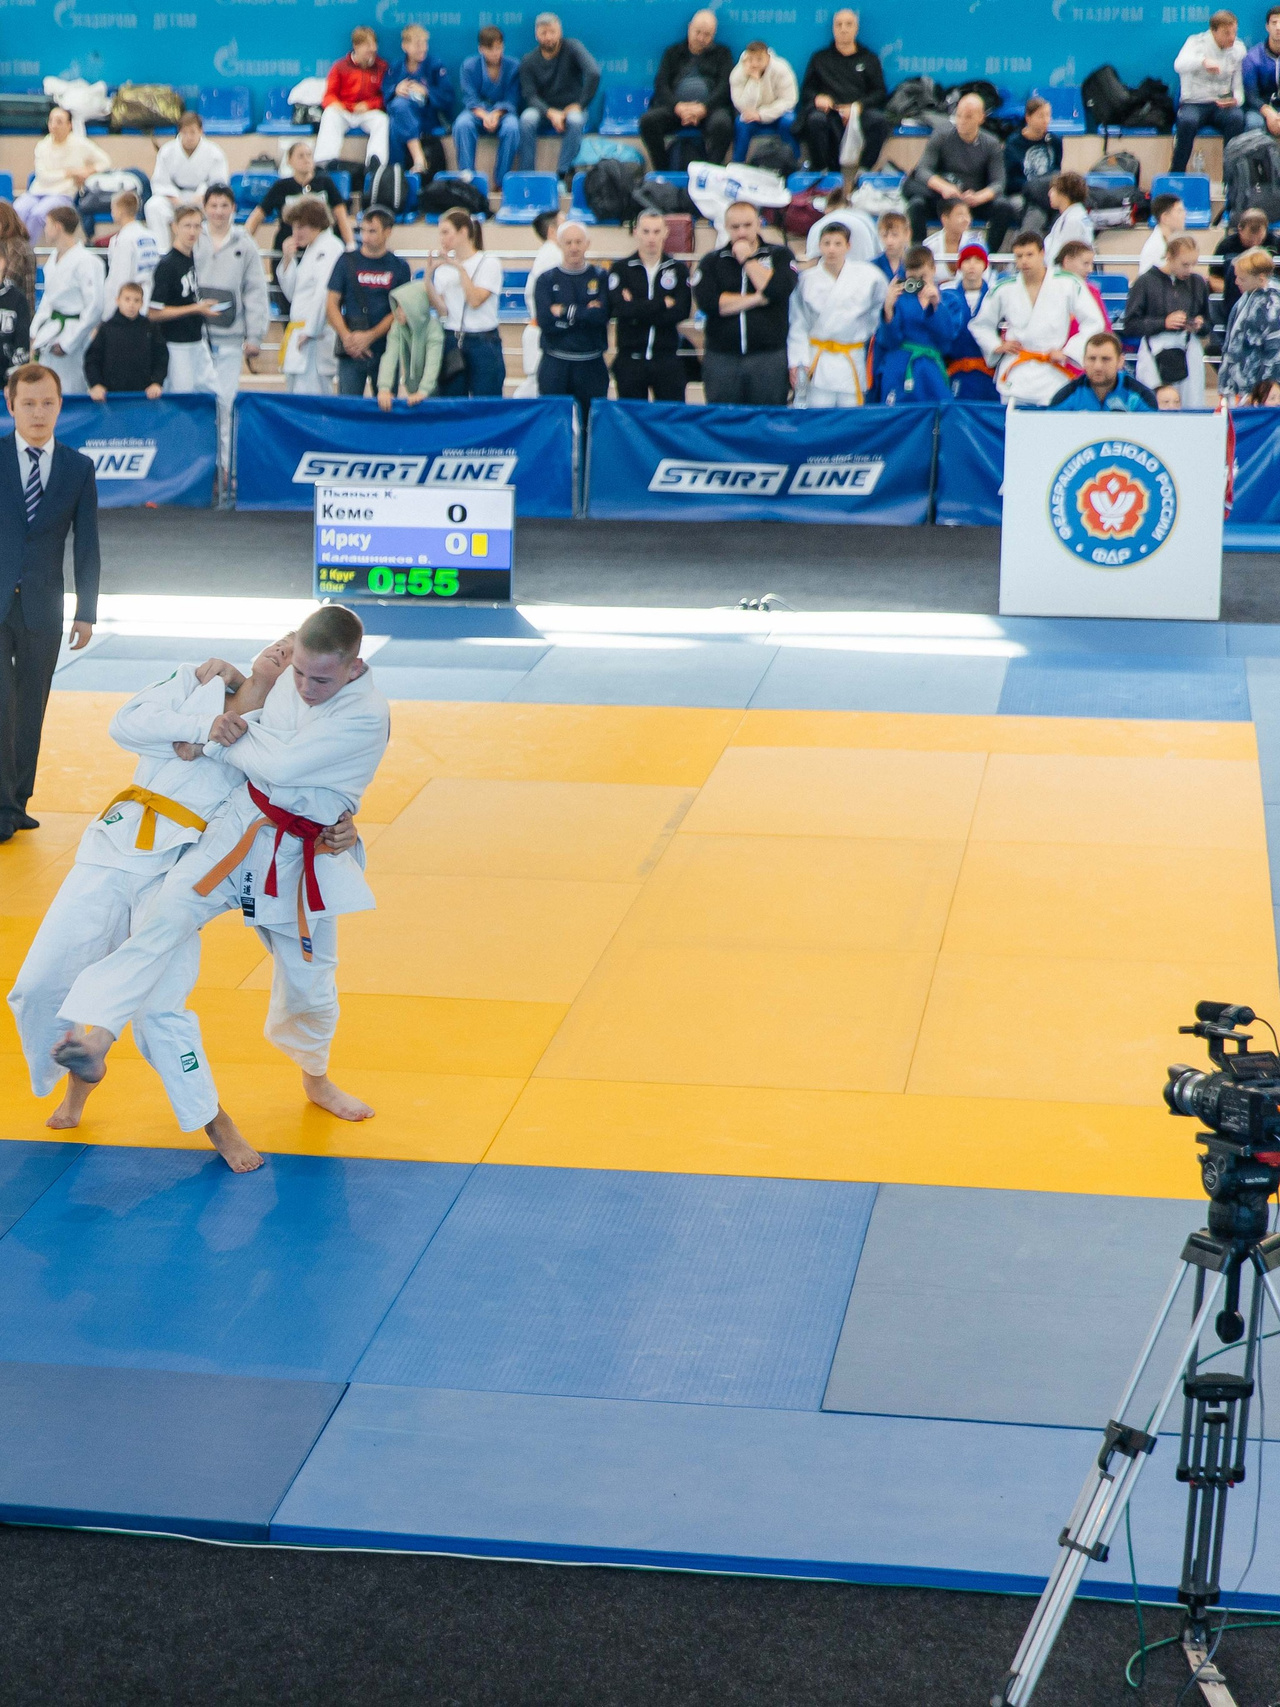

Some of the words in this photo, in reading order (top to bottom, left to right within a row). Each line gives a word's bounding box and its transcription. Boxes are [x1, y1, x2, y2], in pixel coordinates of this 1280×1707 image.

[94, 453, 145, 472] INE
[303, 458, 420, 481] START
[433, 462, 505, 481] LINE
[658, 466, 781, 489] START
[796, 469, 872, 489] LINE
[1051, 446, 1096, 541] ФЕДЕРАЦИЯ
[1099, 441, 1160, 473] ДЗЮДО
[1151, 471, 1175, 542] РОССИИ
[322, 503, 375, 521] Кеме
[447, 504, 468, 523] 0
[320, 528, 372, 552] Ирку
[444, 532, 468, 556] 0
[321, 552, 414, 564] Калашников
[367, 566, 460, 597] 0:55
